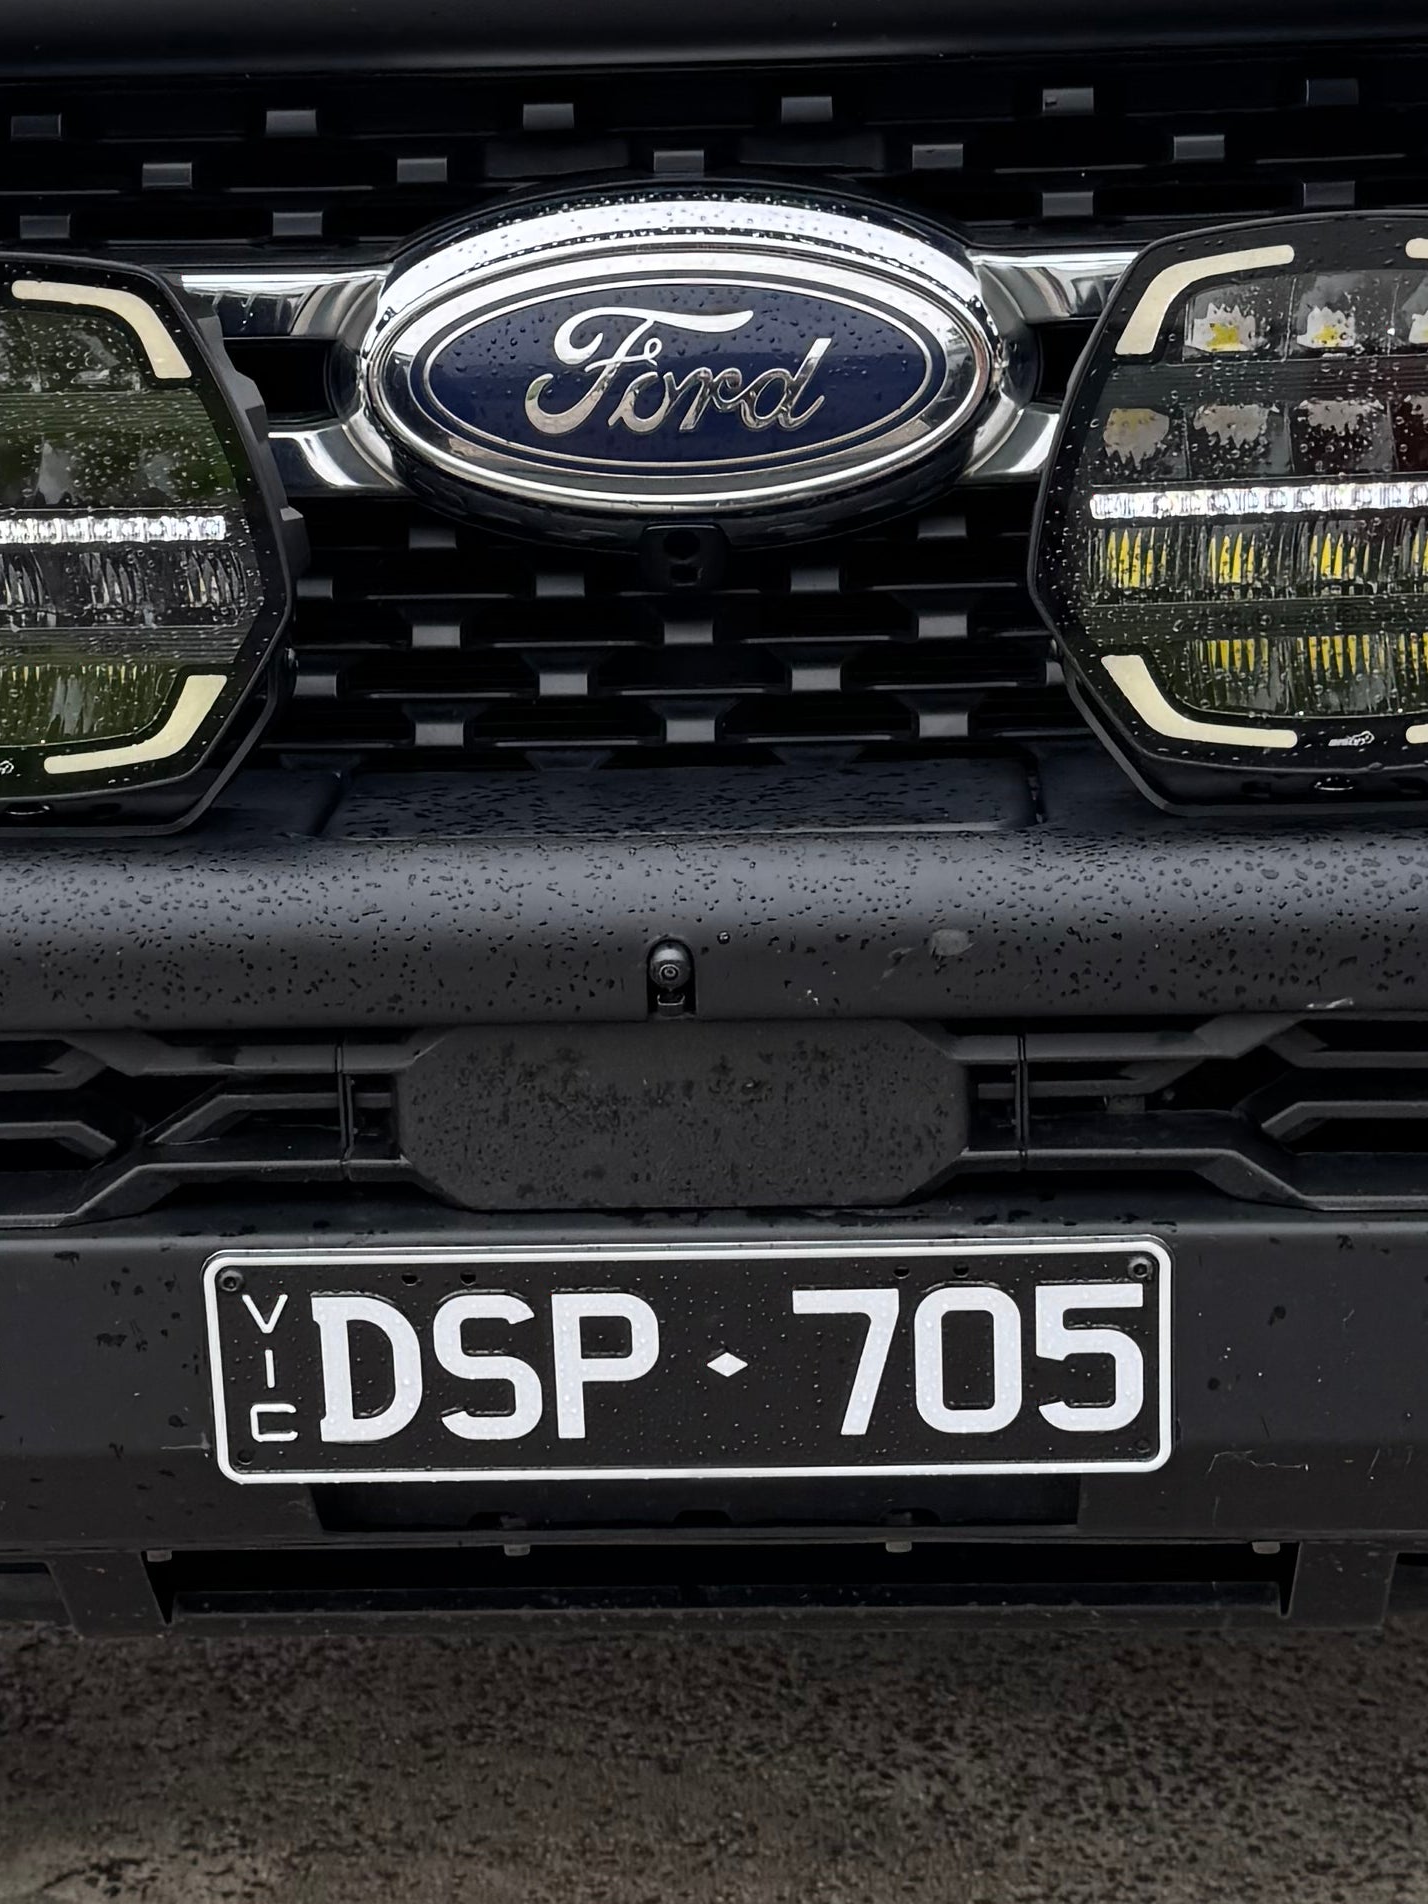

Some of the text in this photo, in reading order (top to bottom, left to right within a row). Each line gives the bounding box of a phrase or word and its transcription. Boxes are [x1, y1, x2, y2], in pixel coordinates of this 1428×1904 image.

[524, 306, 833, 435] Ford
[241, 1294, 299, 1443] VIC
[310, 1282, 1145, 1443] DSP 705
